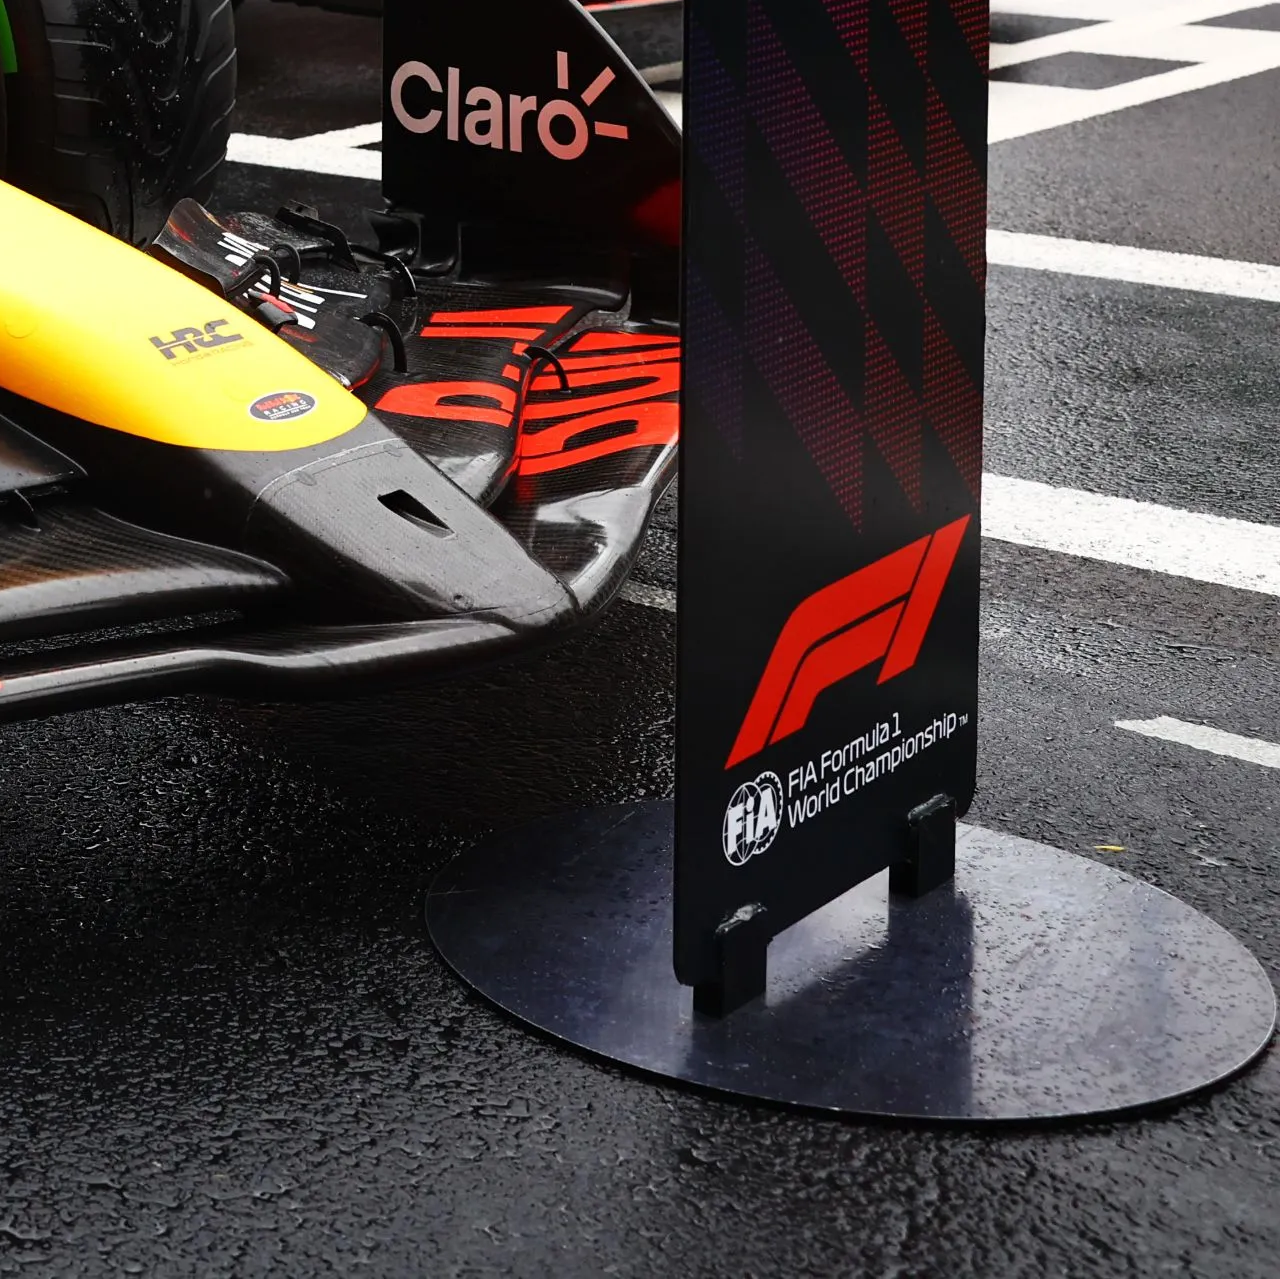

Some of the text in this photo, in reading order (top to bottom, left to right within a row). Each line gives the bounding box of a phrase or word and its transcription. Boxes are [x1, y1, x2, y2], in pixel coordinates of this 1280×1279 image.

[391, 60, 590, 161] Claro
[148, 318, 245, 361] HRC
[787, 776, 841, 829] World
[842, 712, 957, 796] Championship
[788, 711, 903, 799] FIA Formula 1
